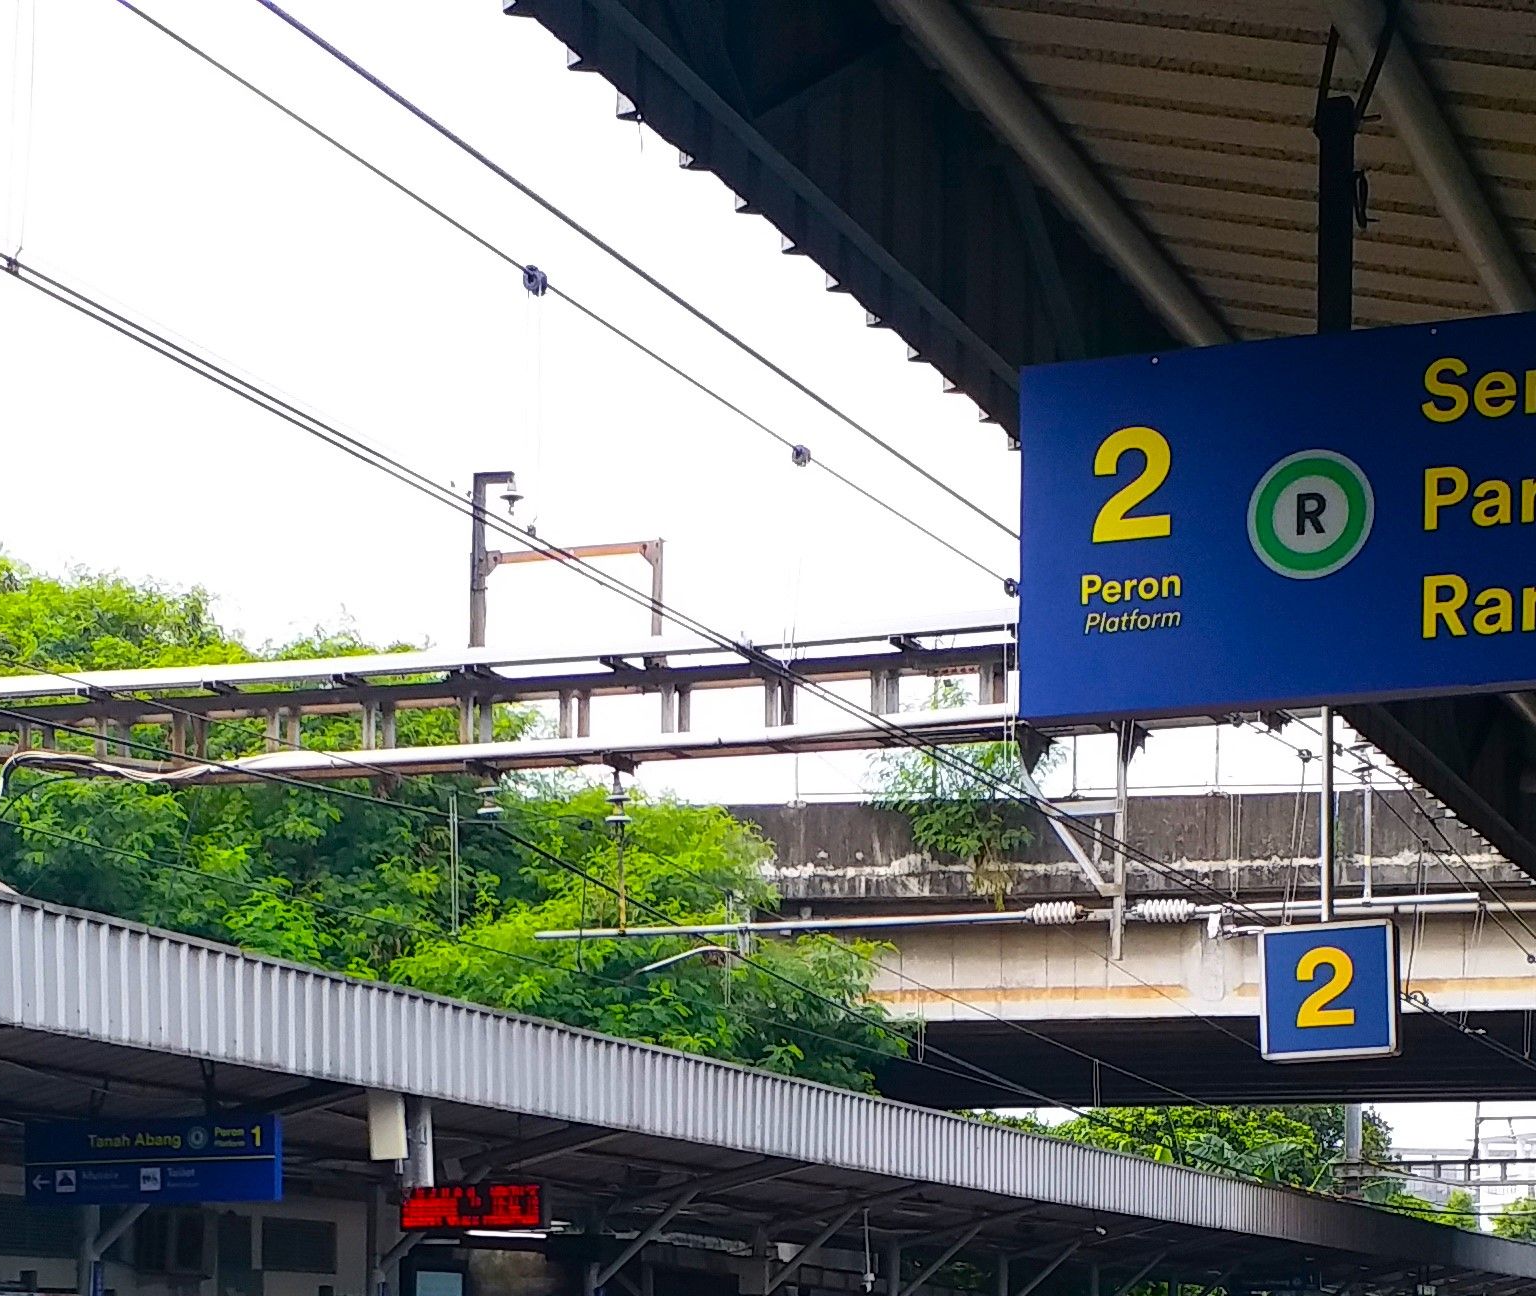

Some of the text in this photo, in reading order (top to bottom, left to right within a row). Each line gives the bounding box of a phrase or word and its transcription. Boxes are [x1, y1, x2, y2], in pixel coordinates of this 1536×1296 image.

[1091, 426, 1171, 542] 2
[1296, 492, 1326, 536] R
[1080, 571, 1182, 605] Peron
[1084, 607, 1182, 635] Platform
[1295, 946, 1356, 1029] 2
[88, 1131, 183, 1149] Tanah Abang
[251, 1125, 262, 1147] 1
